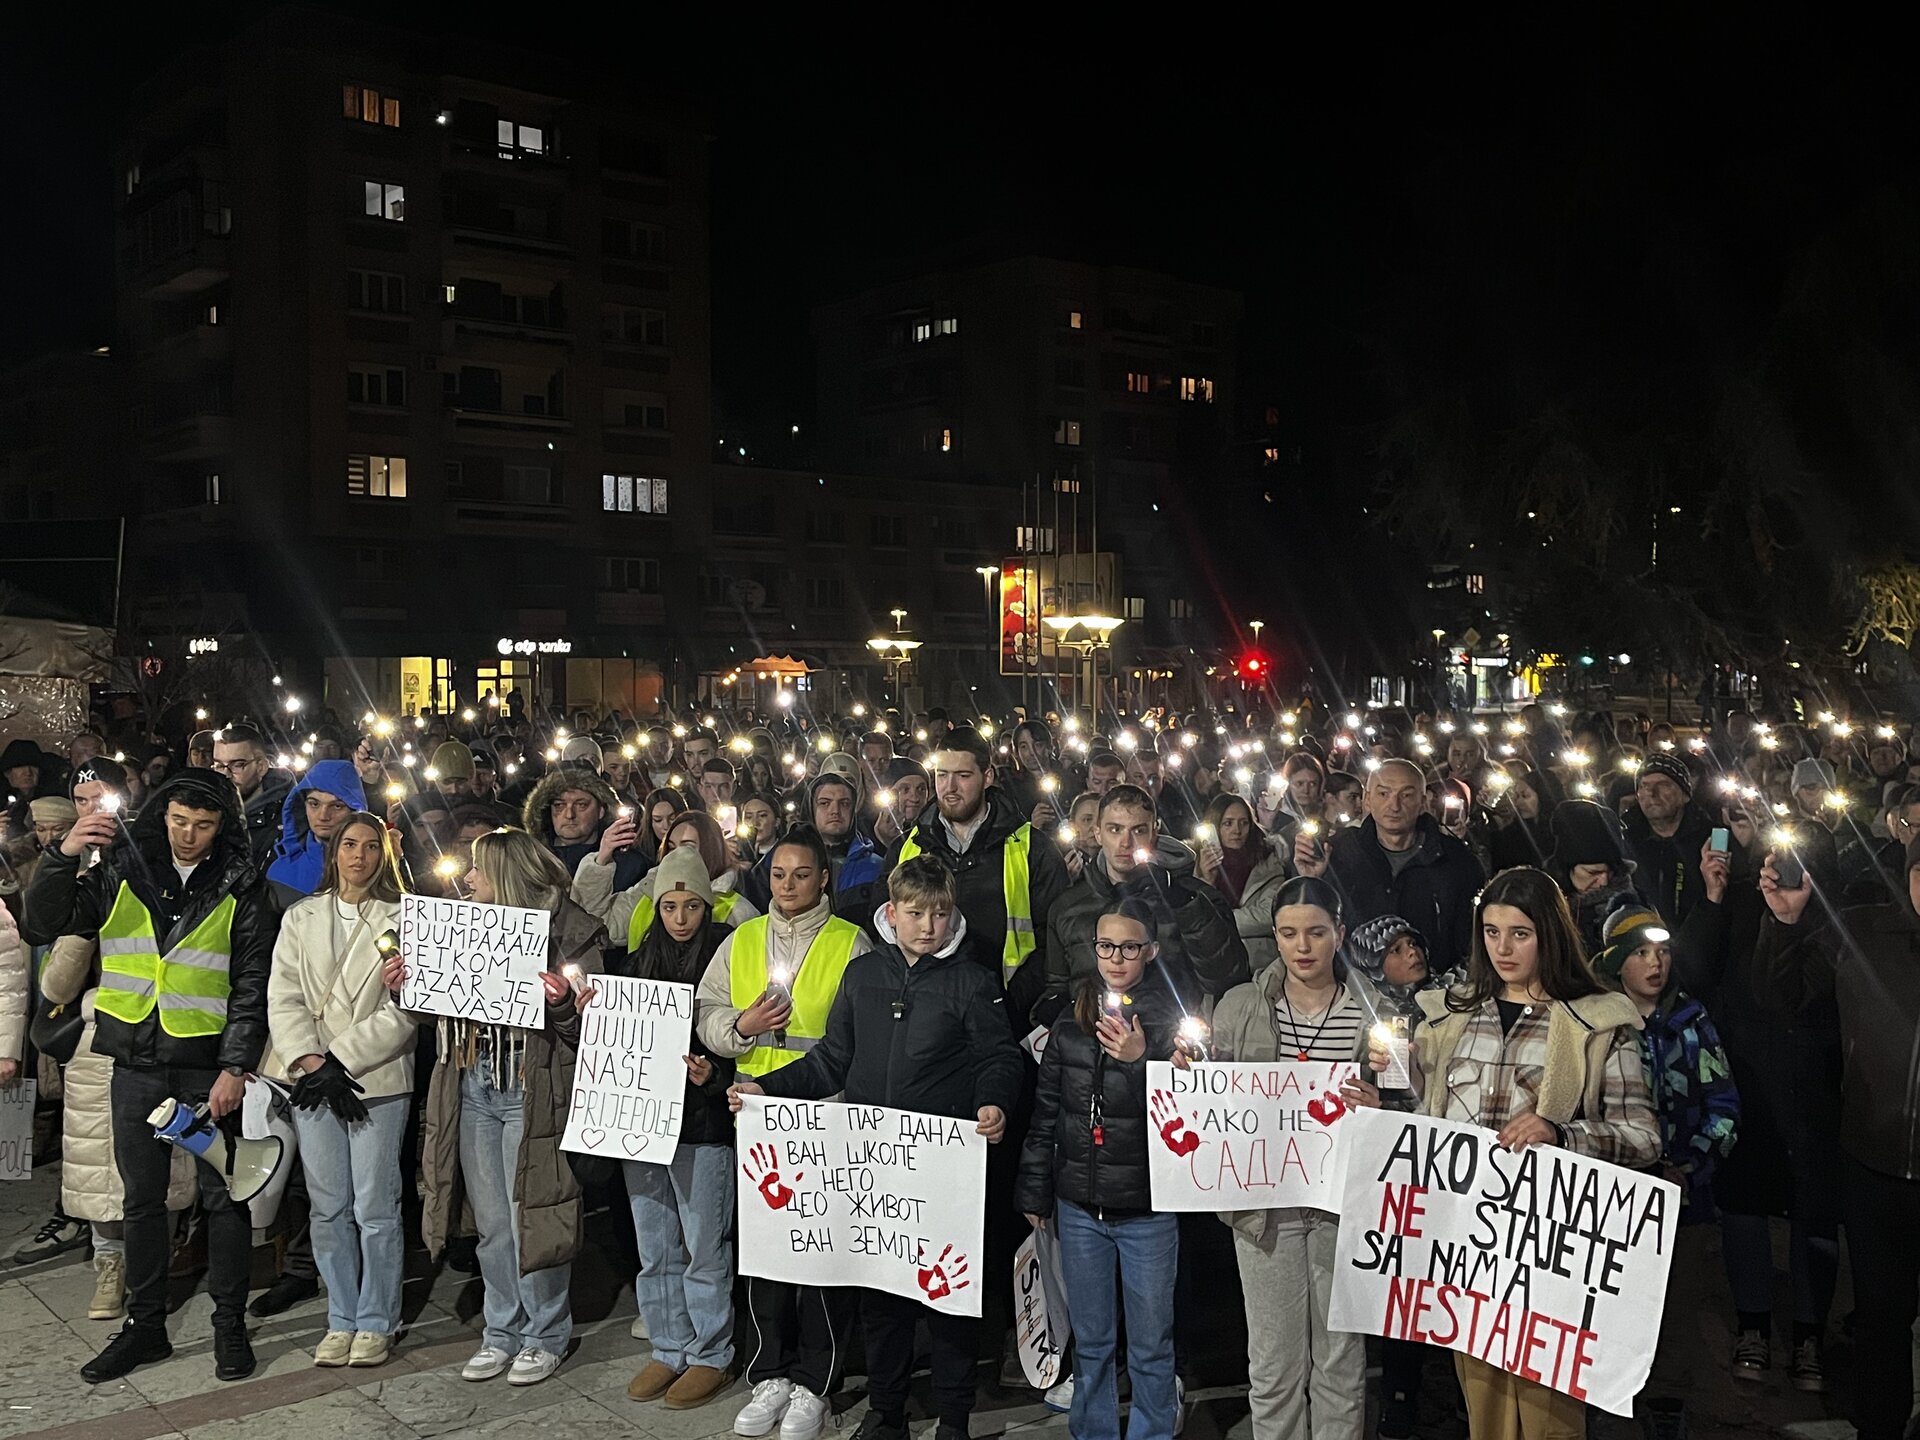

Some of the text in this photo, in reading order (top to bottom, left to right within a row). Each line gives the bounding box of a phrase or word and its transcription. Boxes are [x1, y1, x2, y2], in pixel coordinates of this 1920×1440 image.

[514, 639, 537, 656] otp
[403, 920, 548, 957] PUUMPAAA!!!
[403, 942, 510, 978] PETKOM
[403, 965, 534, 1005] PAZAR JE
[402, 988, 539, 1027] UZ VAS!!!
[584, 1013, 654, 1053] UUUU
[579, 1049, 652, 1092] NAŠE
[764, 1103, 965, 1146] БОЉЕ ПАР ДАНА
[1202, 1108, 1313, 1134] АКО НЕ
[786, 1141, 917, 1170] ВАН ШКОЛЕ
[822, 1168, 874, 1192] НЕГО
[1377, 1124, 1666, 1255] AKO SA NAMA
[785, 1191, 926, 1224] ЦЕО ЖИВОТ
[790, 1226, 930, 1267] ВАН ЗЕМЉЕ
[1379, 1182, 1629, 1296] NE STAJETE
[1352, 1230, 1403, 1277] SA
[1428, 1240, 1530, 1311] NAMA
[1383, 1276, 1598, 1401] NESTAJETE
